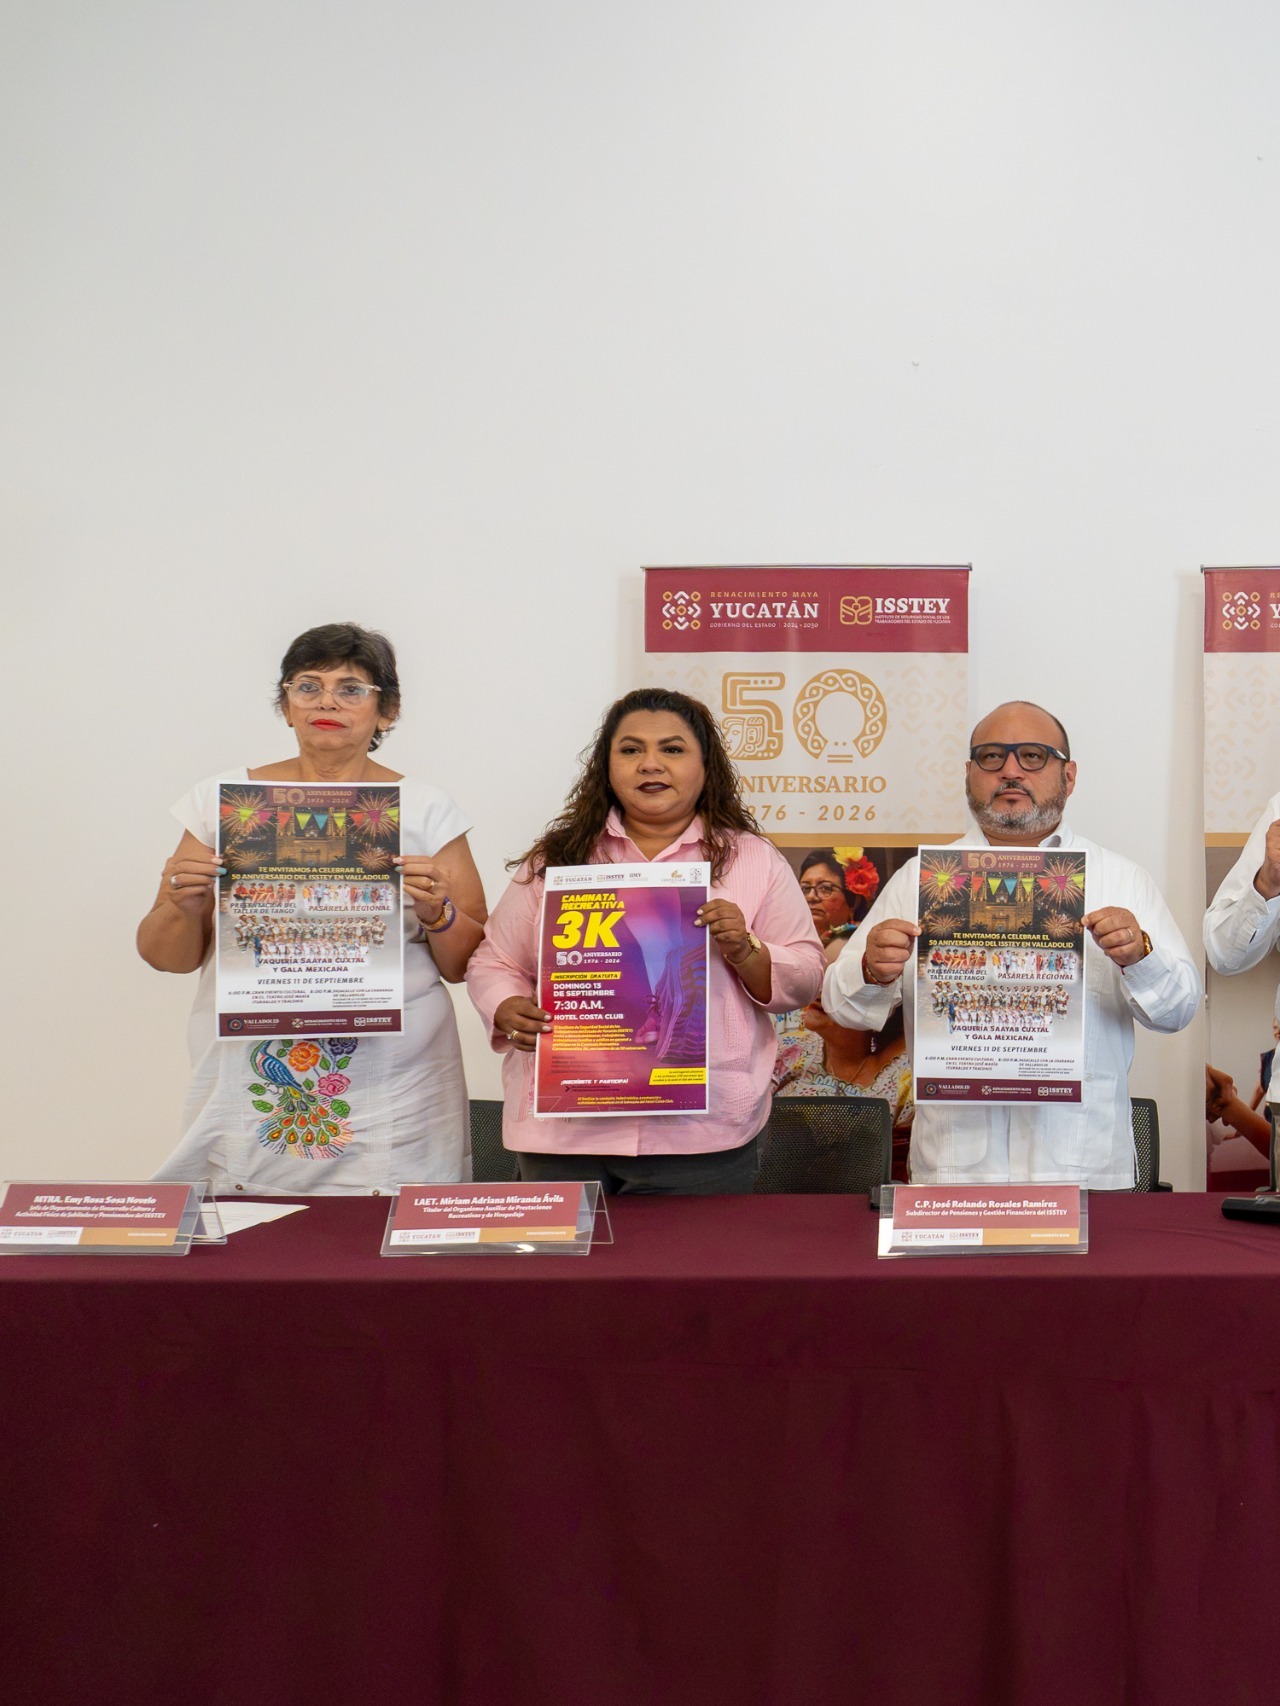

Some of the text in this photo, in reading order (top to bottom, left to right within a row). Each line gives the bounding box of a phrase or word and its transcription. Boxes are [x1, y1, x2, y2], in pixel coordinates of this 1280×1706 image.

[710, 600, 819, 618] YUCATÁN
[875, 598, 950, 613] ISSTEY
[721, 668, 887, 763] 50
[740, 776, 887, 793] NIVERSARIO
[817, 805, 876, 821] 2026
[561, 893, 616, 902] CAMINATA
[561, 901, 624, 911] RECREATIVA
[552, 911, 625, 949] 3K
[556, 951, 582, 966] 50
[554, 1000, 604, 1010] 7:30 A.M.
[64, 1196, 82, 1204] Emy
[414, 1193, 564, 1206] LAET. Miriam Adriana Miranda Ávila
[932, 1200, 950, 1209] José
[989, 1200, 1021, 1208] Rosales
[1023, 1200, 1057, 1208] Ramírez
